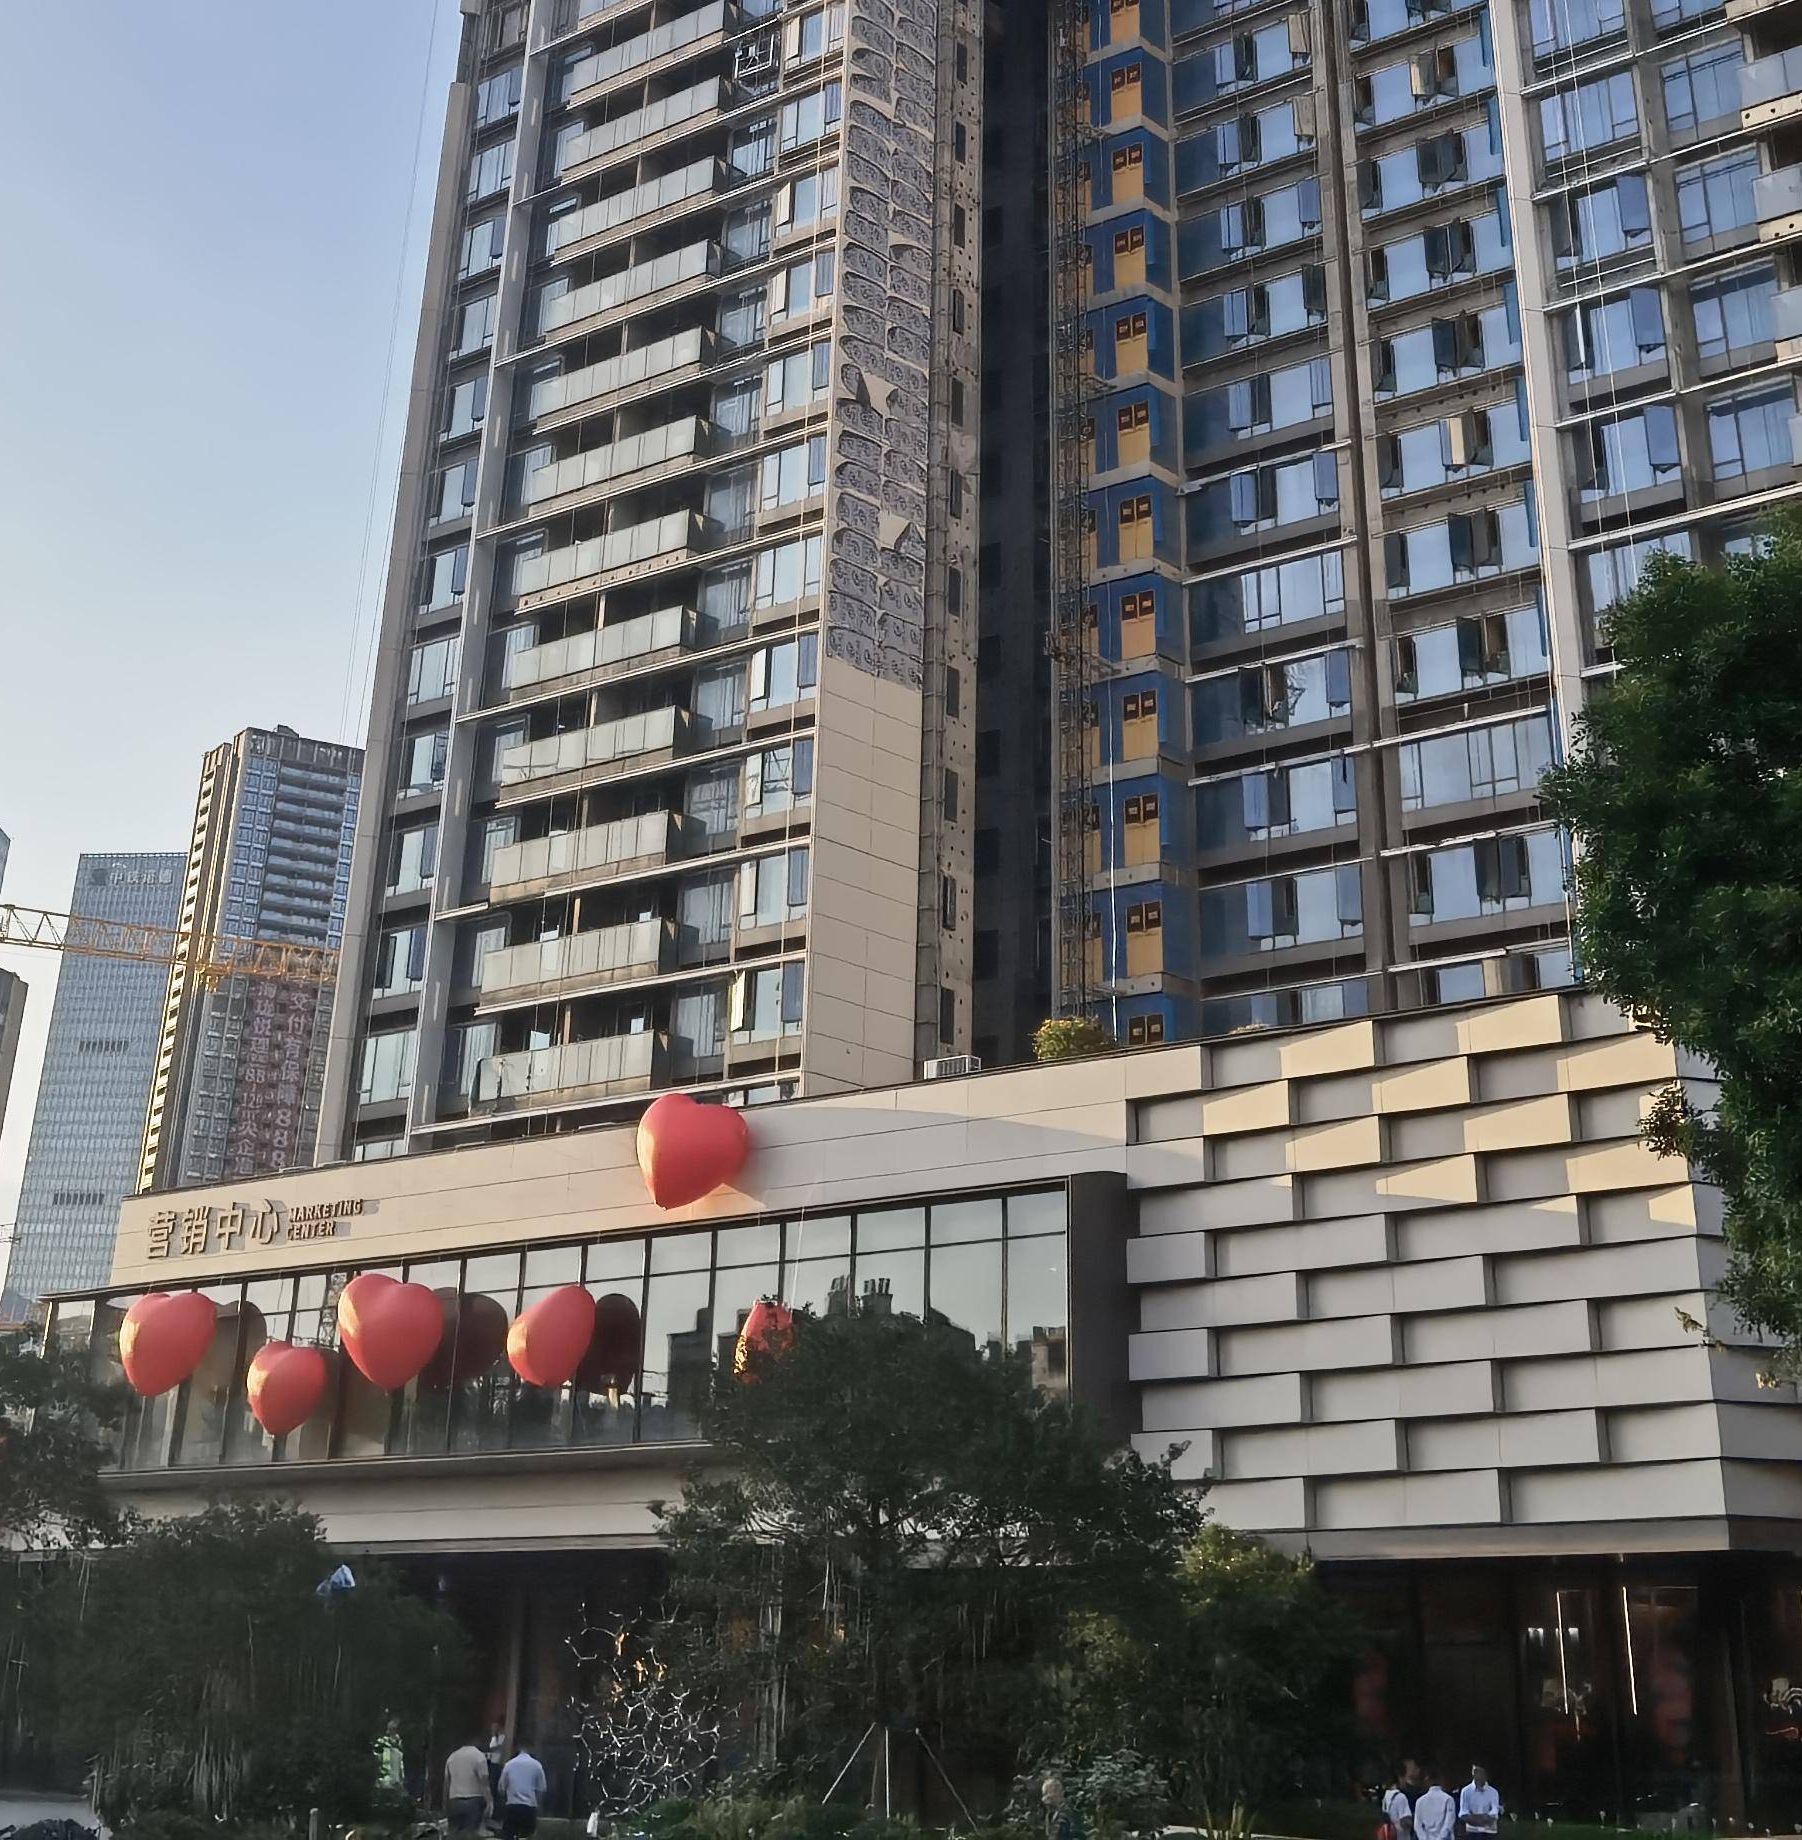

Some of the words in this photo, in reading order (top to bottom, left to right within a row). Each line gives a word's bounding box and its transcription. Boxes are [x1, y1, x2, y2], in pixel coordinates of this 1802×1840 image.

[288, 1199, 364, 1222] MARKETING
[148, 1198, 280, 1259] 营销中心
[287, 1220, 337, 1241] CENTER
